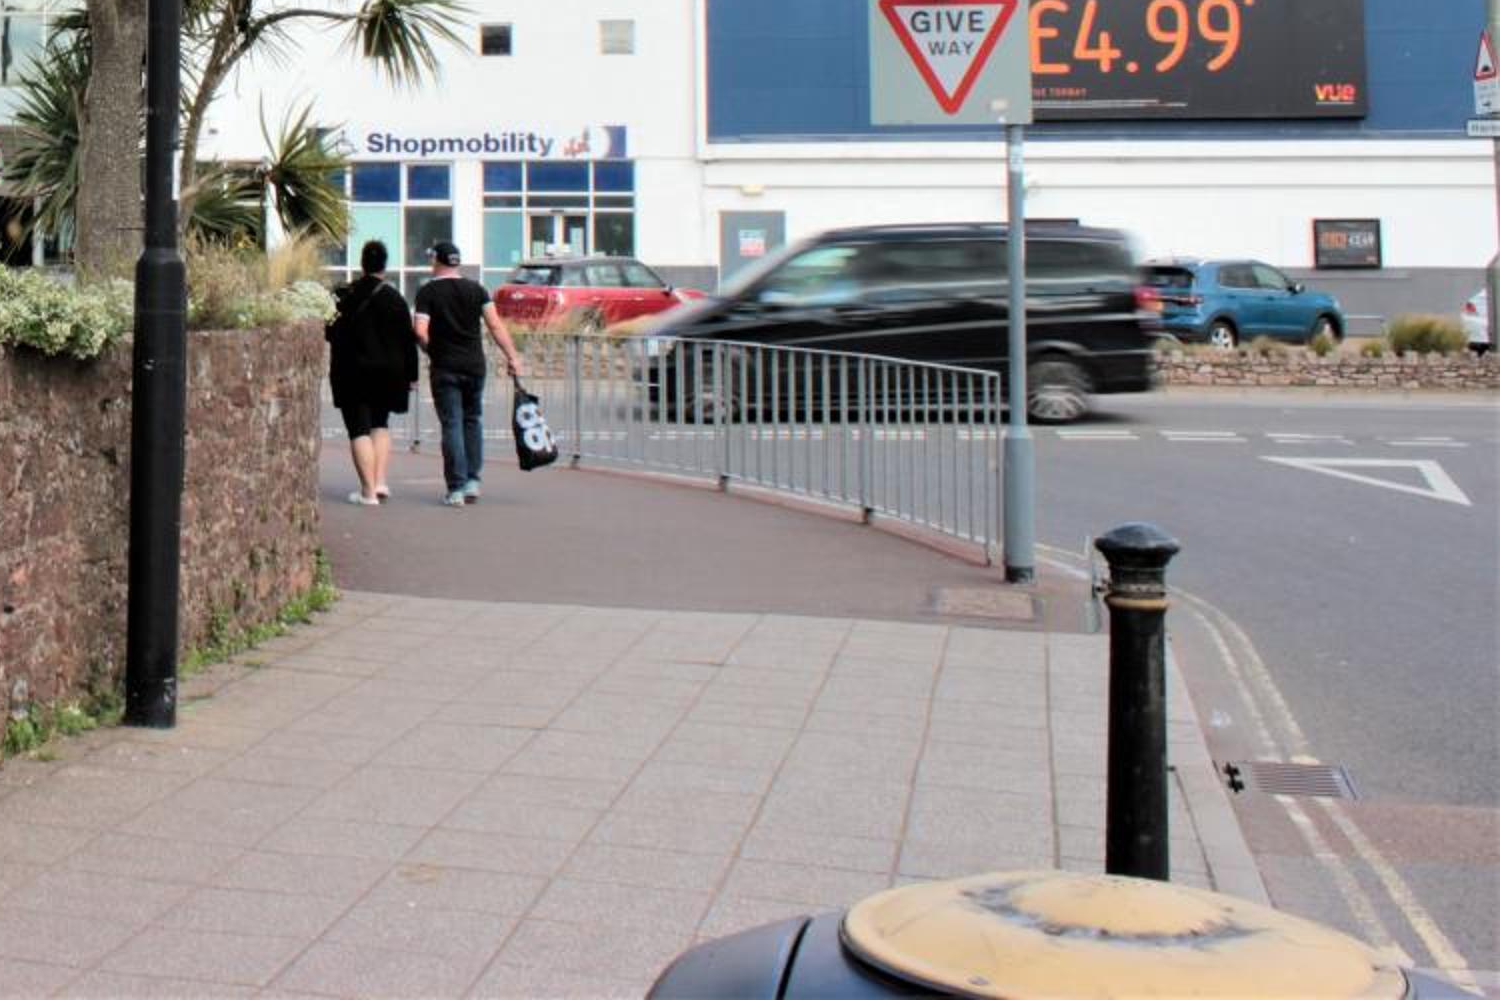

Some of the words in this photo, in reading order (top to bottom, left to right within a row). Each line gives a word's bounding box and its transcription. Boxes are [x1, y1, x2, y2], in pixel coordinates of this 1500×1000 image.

[910, 10, 985, 33] GIVE
[928, 41, 975, 56] WAY
[1315, 83, 1357, 101] vue
[366, 132, 553, 157] Shopmobility
